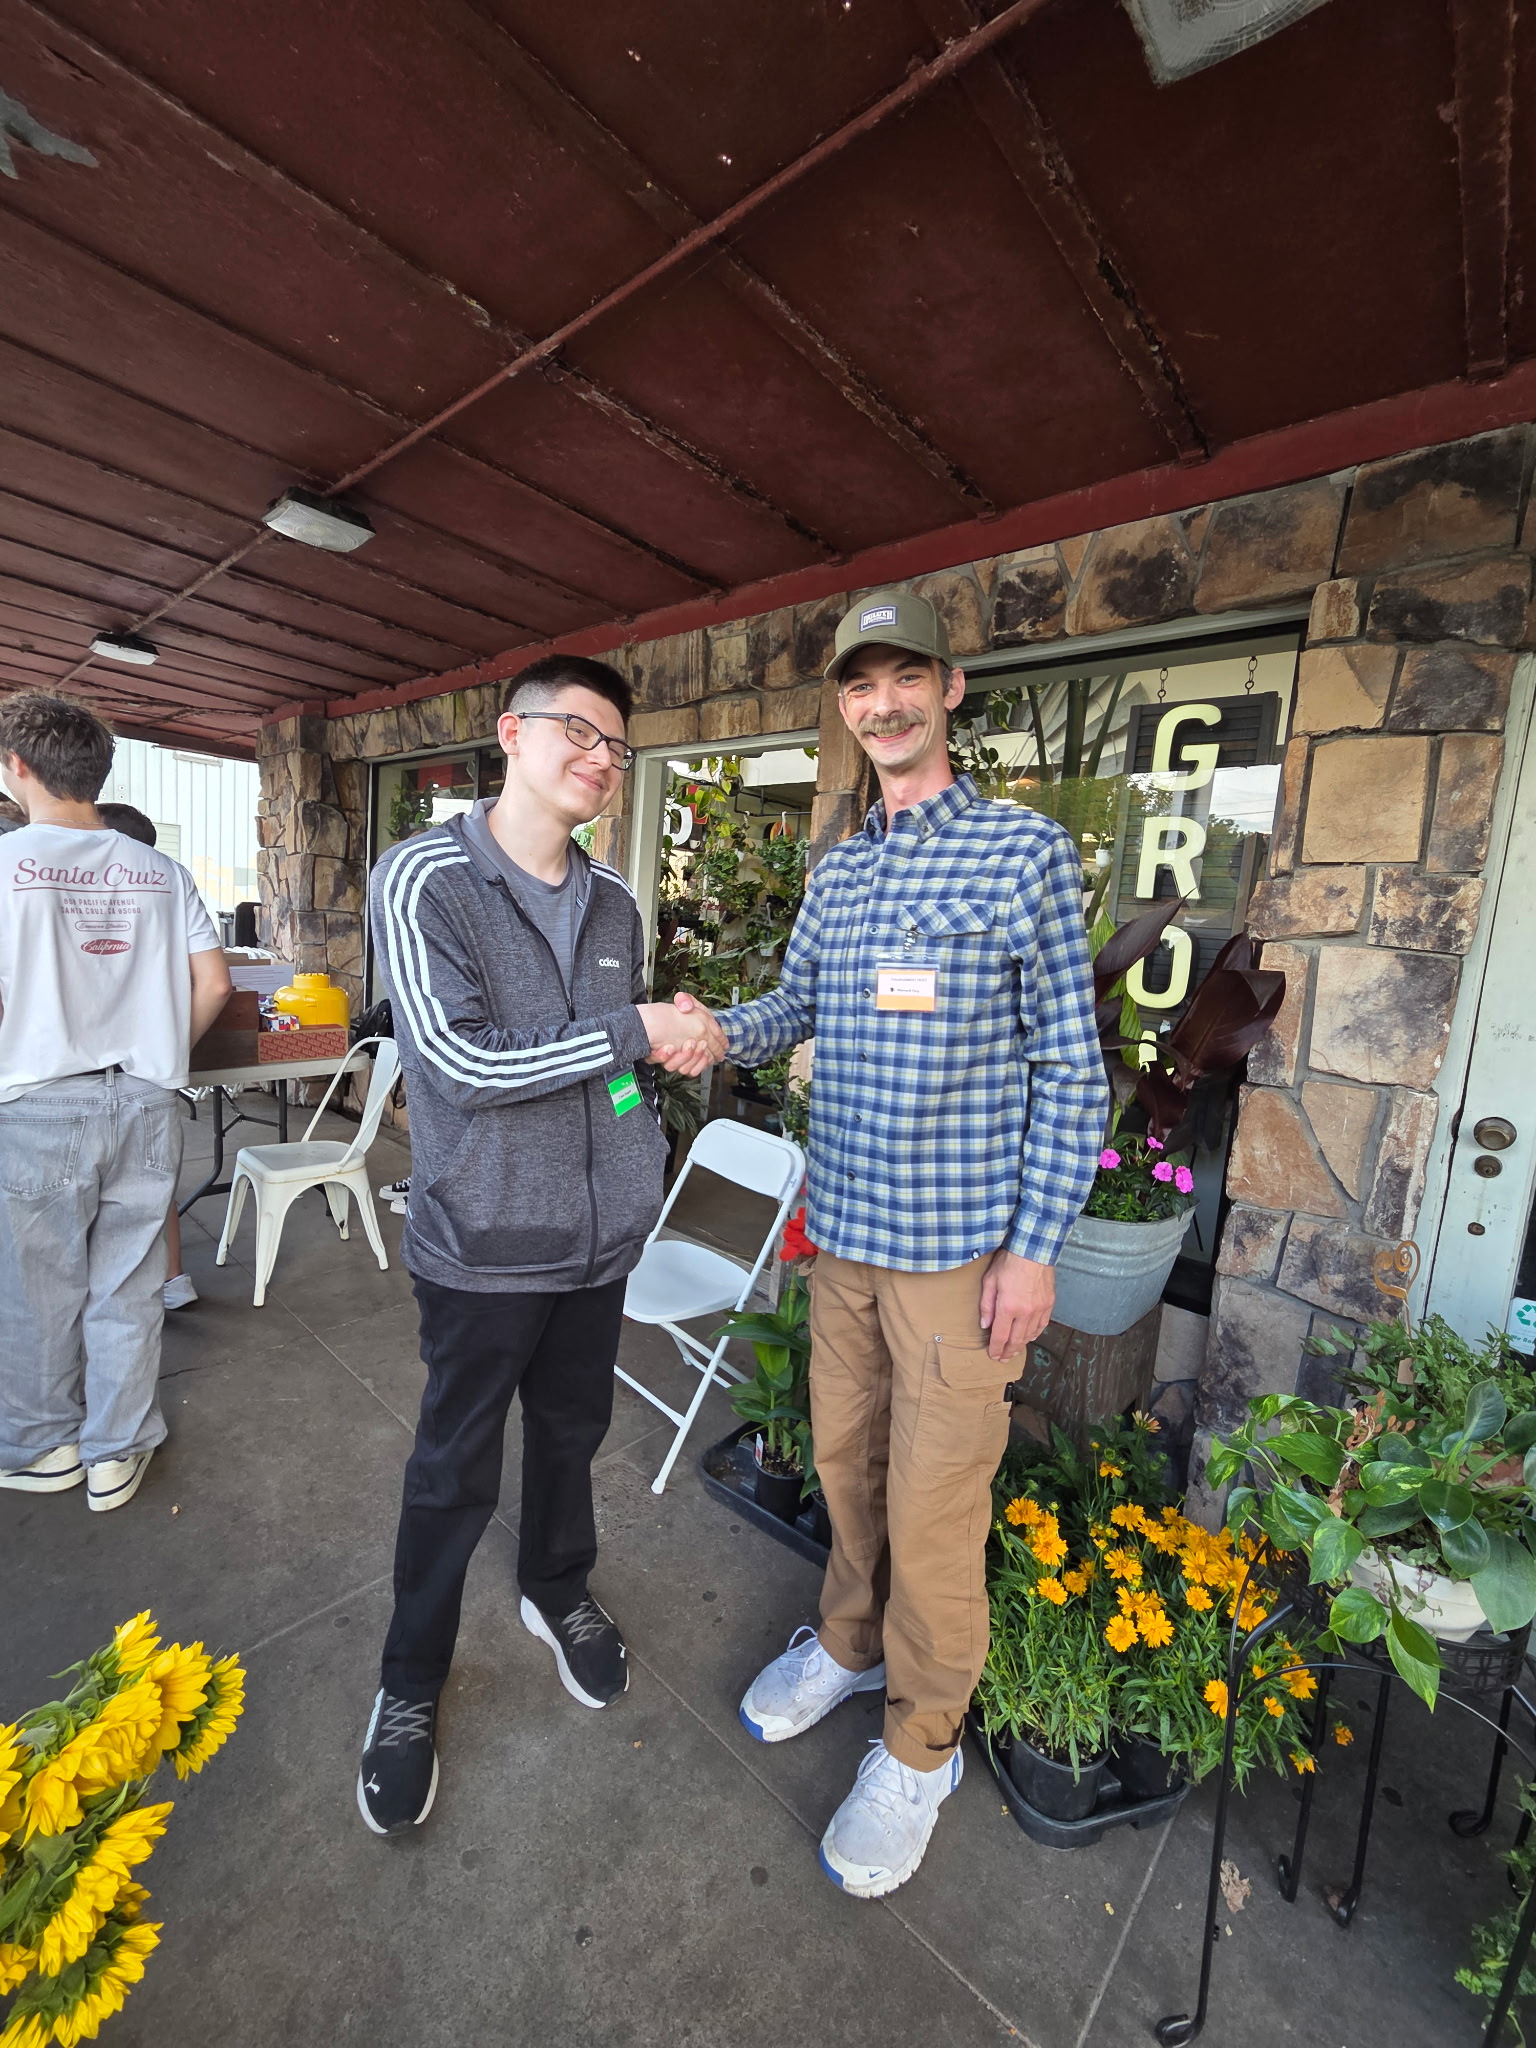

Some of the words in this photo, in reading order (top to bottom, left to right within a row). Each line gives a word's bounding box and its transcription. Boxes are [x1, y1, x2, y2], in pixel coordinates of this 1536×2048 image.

[13, 858, 99, 885] Santa
[103, 862, 167, 887] Cruz
[79, 898, 107, 906] PACIFIC
[82, 939, 130, 955] California
